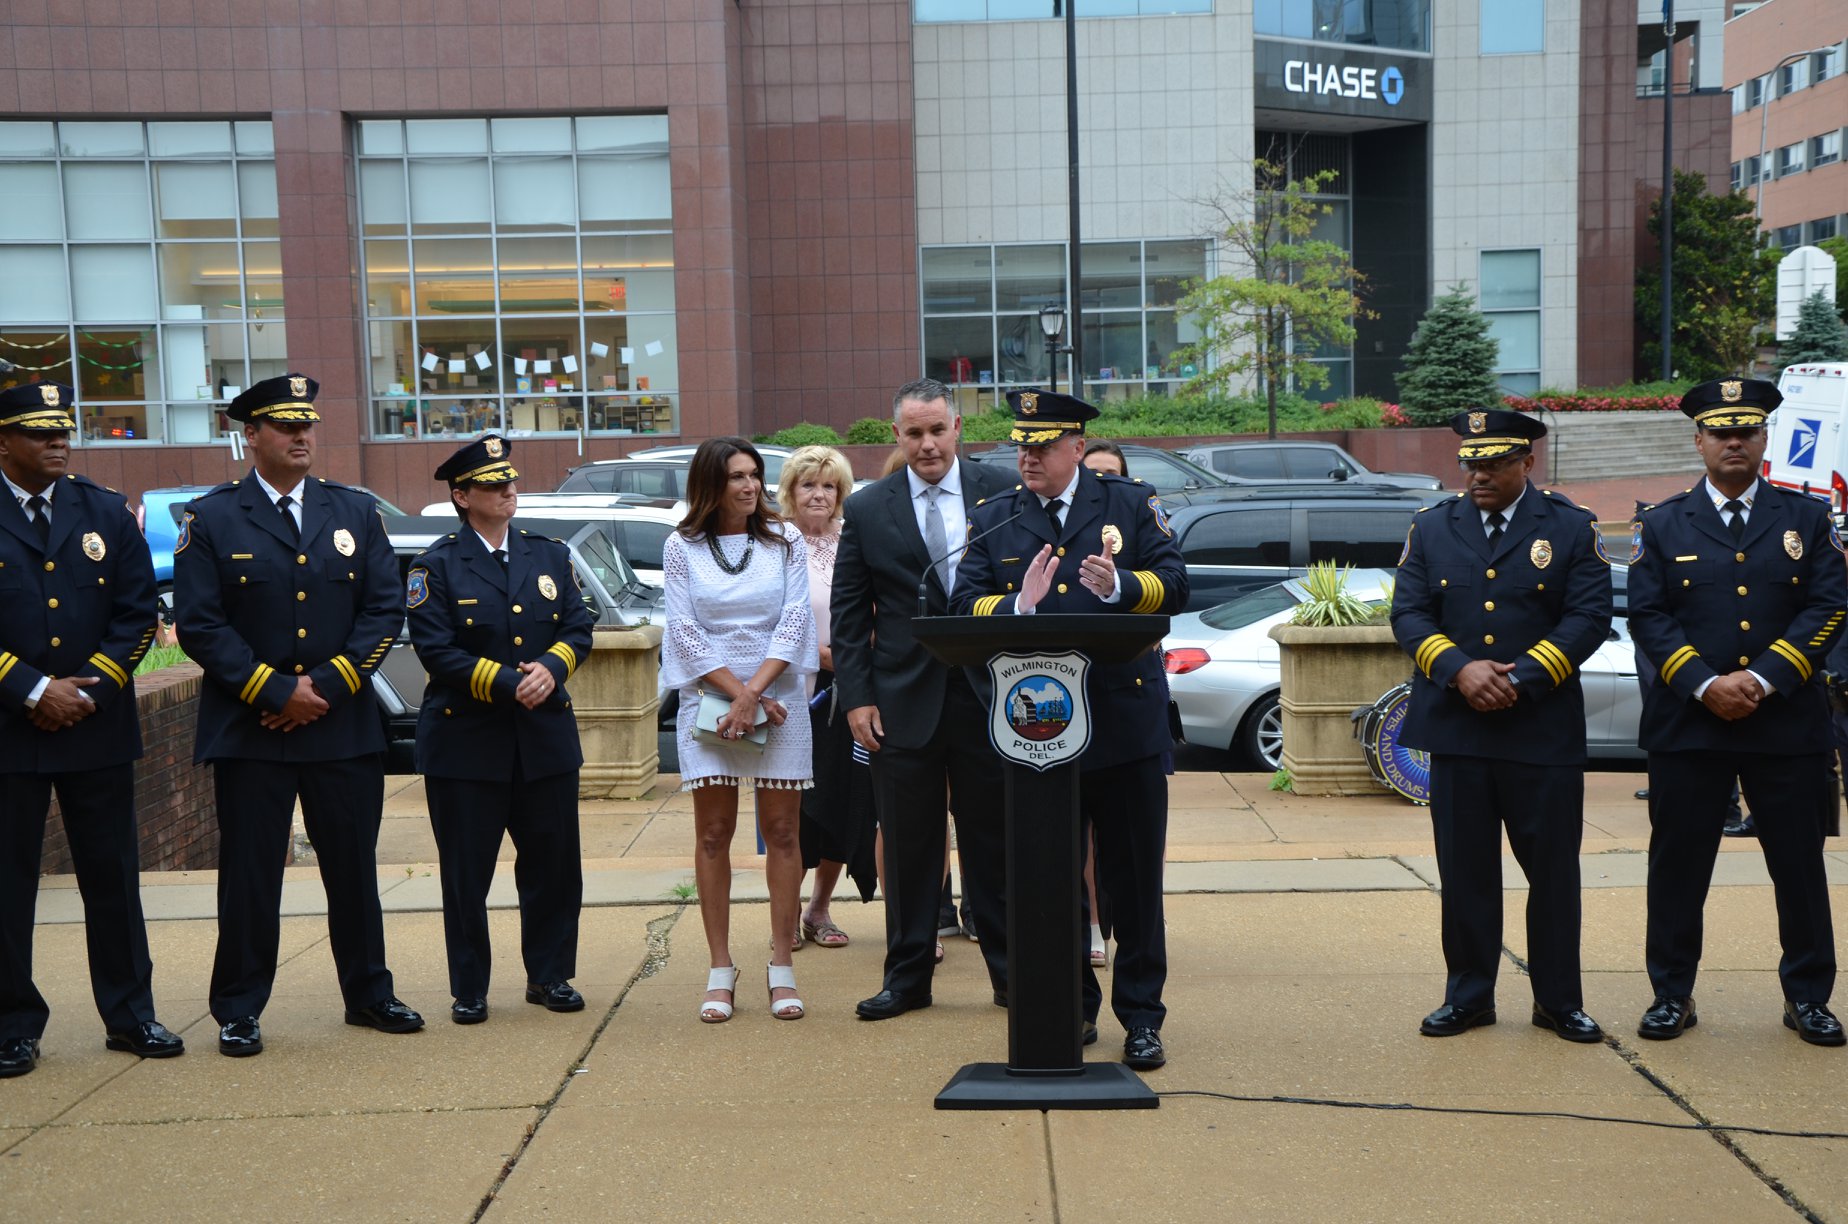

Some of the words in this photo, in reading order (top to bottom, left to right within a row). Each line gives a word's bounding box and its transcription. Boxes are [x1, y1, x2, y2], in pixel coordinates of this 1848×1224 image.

[1284, 60, 1377, 99] CHASE
[1001, 661, 1077, 679] WILMINGTON
[1012, 740, 1067, 752] POLICE
[1029, 752, 1055, 760] DEL.
[1381, 732, 1393, 762] AND
[1386, 763, 1425, 797] DRUMS
